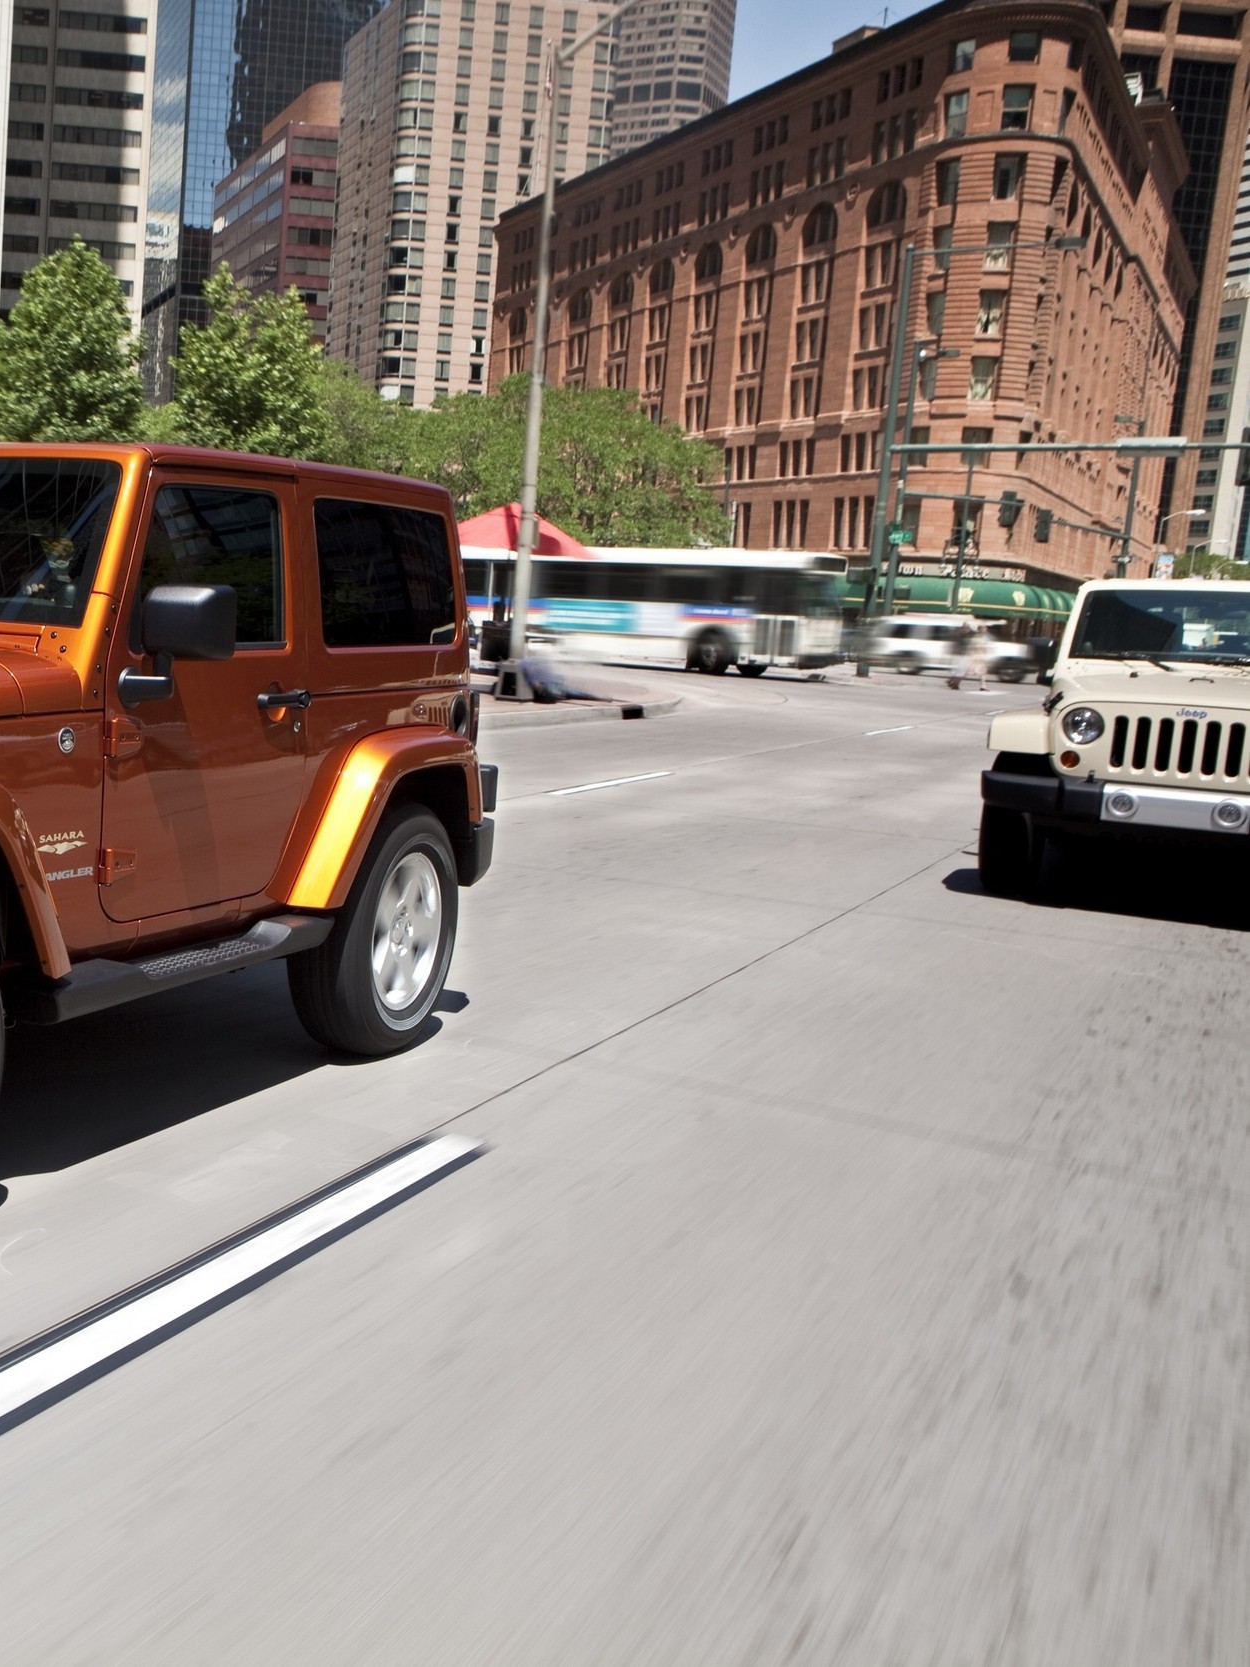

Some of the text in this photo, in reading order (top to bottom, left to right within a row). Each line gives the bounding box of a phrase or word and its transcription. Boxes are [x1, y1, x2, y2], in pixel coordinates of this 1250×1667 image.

[1176, 708, 1207, 719] Jeep
[39, 830, 85, 843] SAHARA
[46, 866, 94, 881] ANGLER
